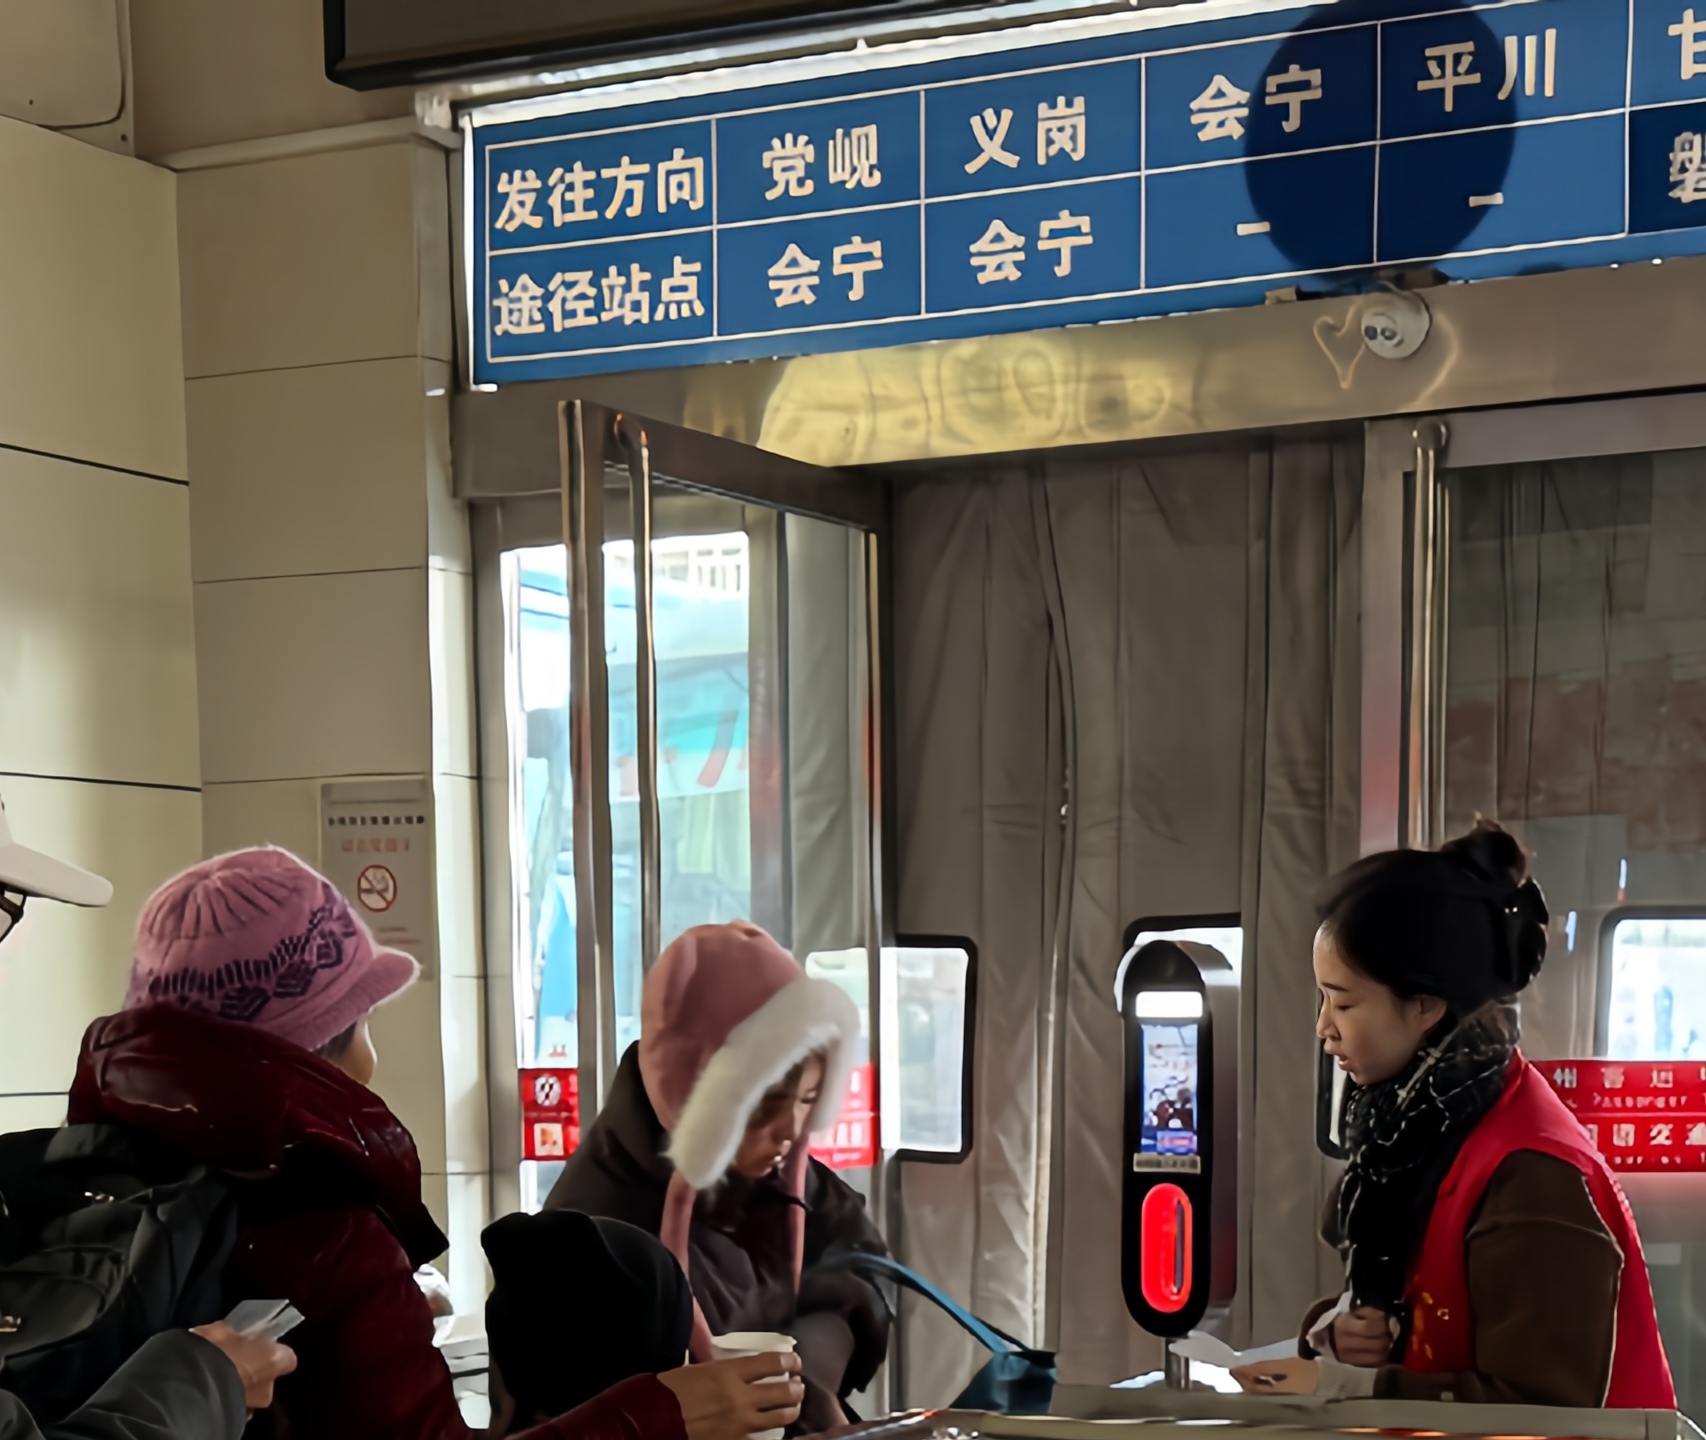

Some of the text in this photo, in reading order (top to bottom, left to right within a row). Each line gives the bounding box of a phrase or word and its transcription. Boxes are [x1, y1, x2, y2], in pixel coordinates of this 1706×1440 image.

[495, 148, 705, 232] 发往方向
[763, 124, 880, 200] 党岘
[965, 96, 1086, 174] 义岗
[1190, 65, 1324, 142] 会宁
[1418, 29, 1557, 111] 平川
[493, 258, 705, 338] 途径站点
[768, 236, 884, 308] 会宁
[970, 210, 1094, 284] 会宁
